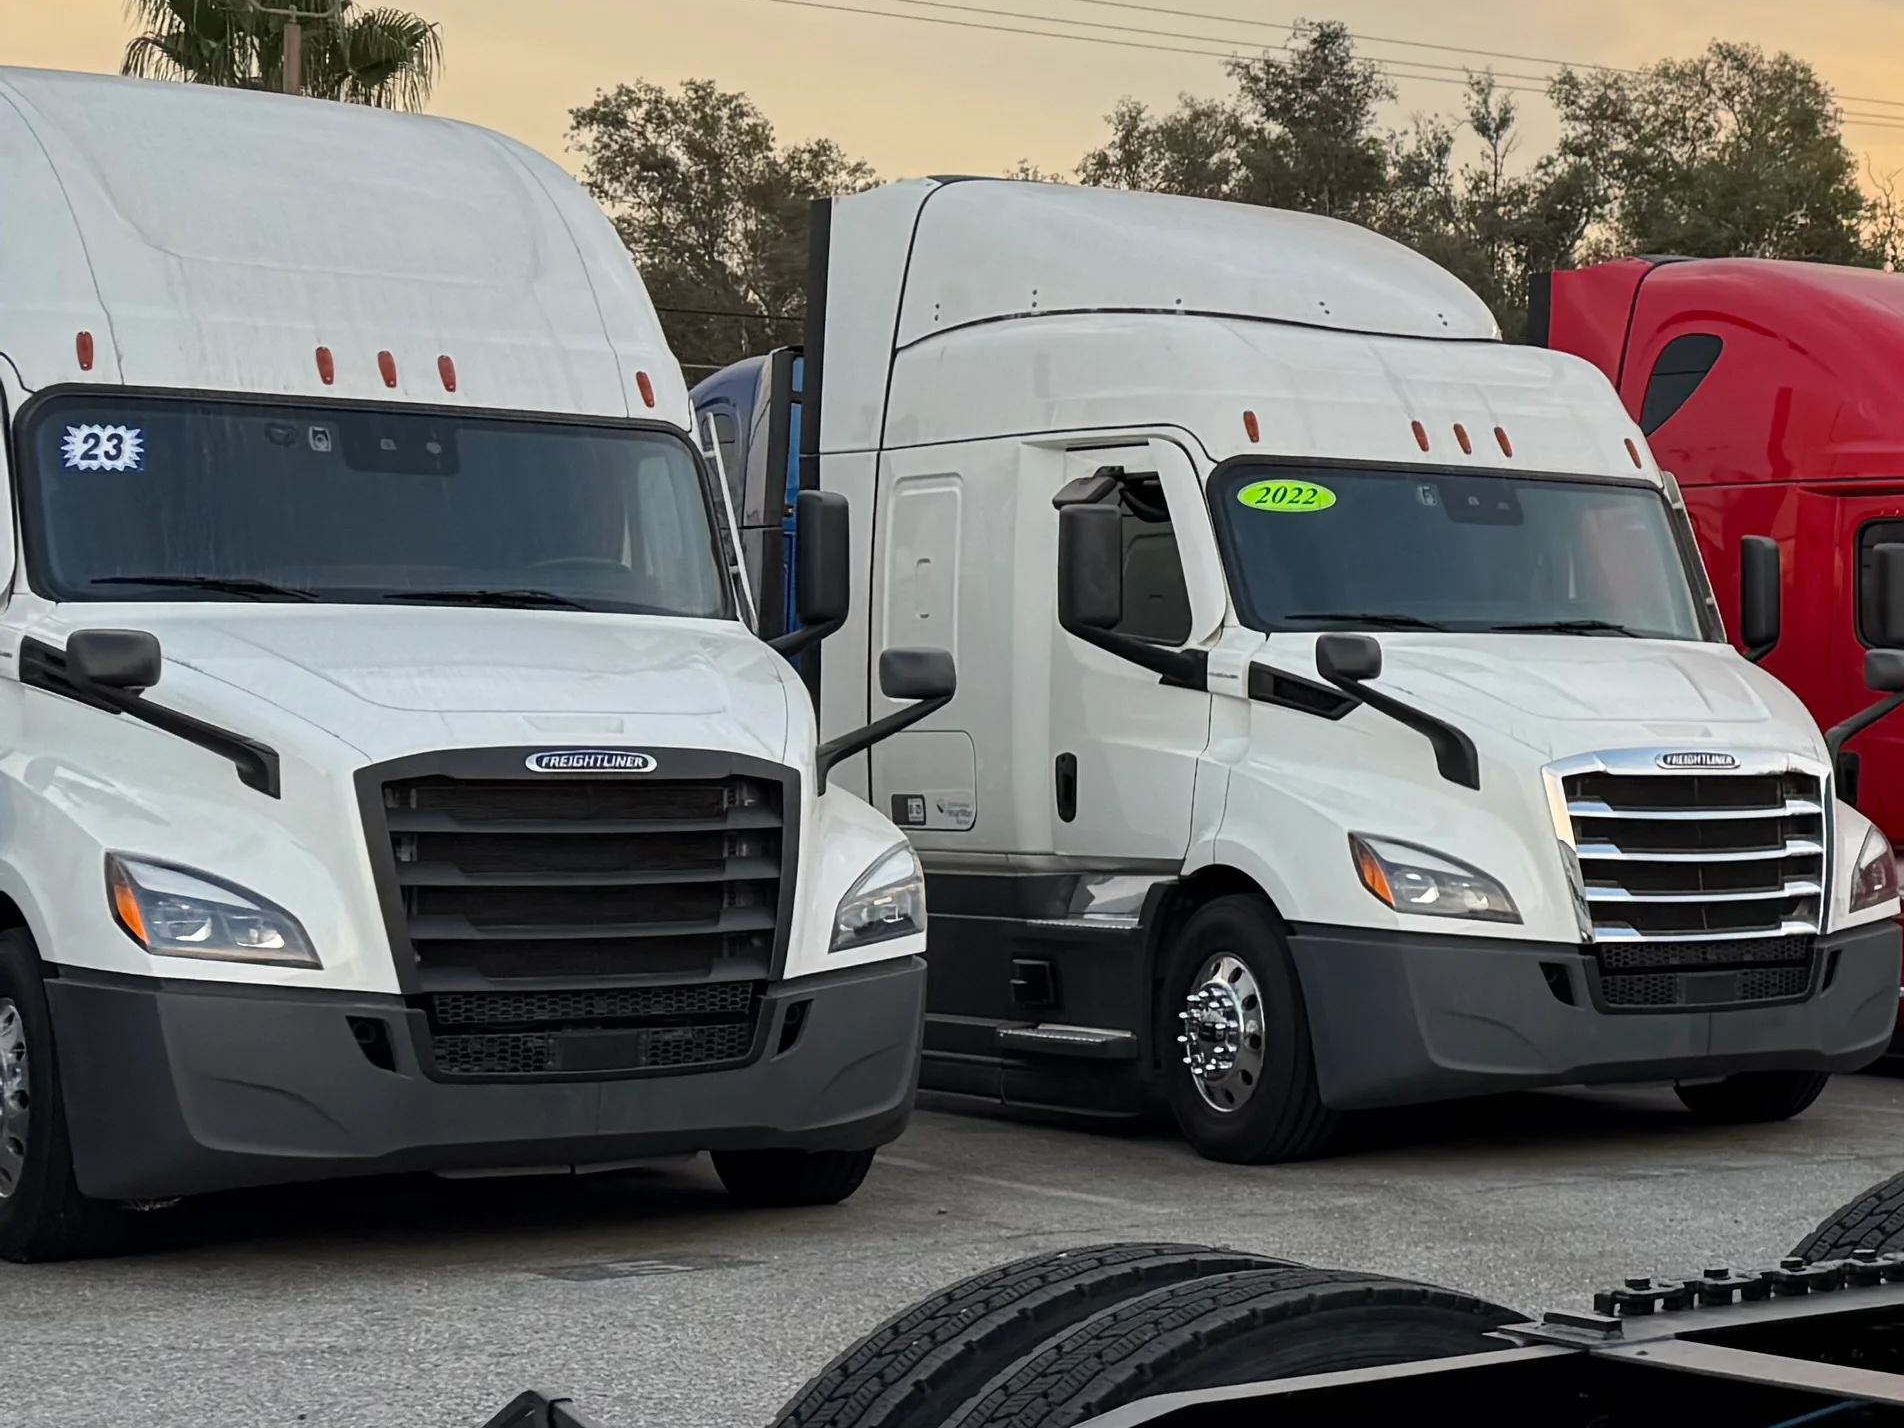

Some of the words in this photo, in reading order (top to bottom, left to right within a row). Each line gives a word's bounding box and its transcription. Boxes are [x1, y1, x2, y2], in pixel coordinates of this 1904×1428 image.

[79, 432, 124, 461] 23
[1254, 486, 1319, 505] 2022
[541, 754, 643, 768] FREIGHTLINER
